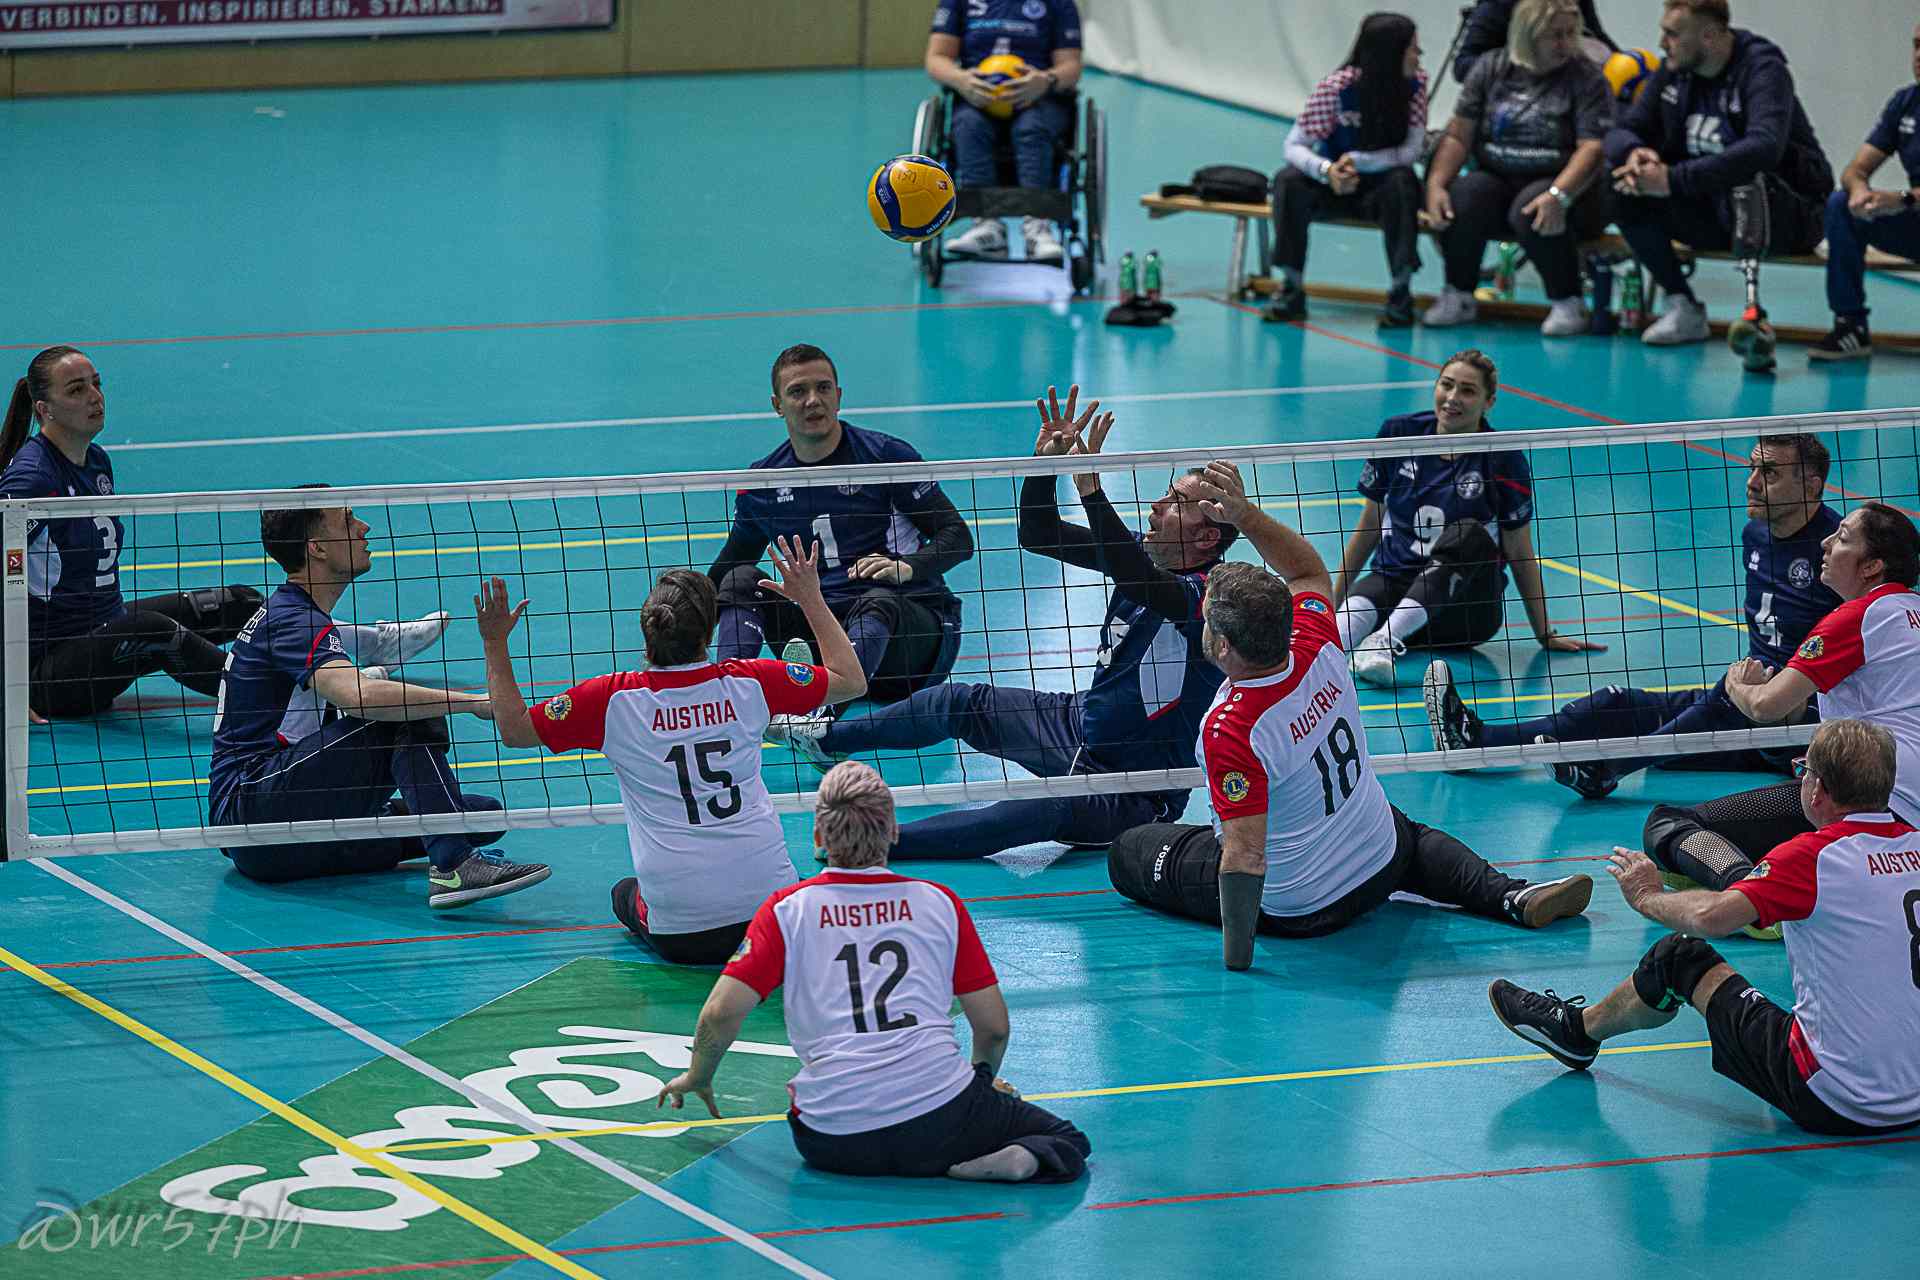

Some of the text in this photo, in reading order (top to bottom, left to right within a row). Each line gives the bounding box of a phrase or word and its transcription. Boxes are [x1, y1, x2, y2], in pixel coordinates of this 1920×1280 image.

[93, 516, 118, 572] 3
[811, 513, 841, 568] 1
[1409, 504, 1446, 557] 9
[1754, 592, 1785, 648] 4
[652, 699, 738, 732] AUSTRIA
[1288, 679, 1343, 745] AUSTRIA
[664, 739, 742, 825] 15
[1309, 716, 1362, 817] 18
[819, 899, 913, 929] AUSTRIA
[834, 939, 919, 1034] 12
